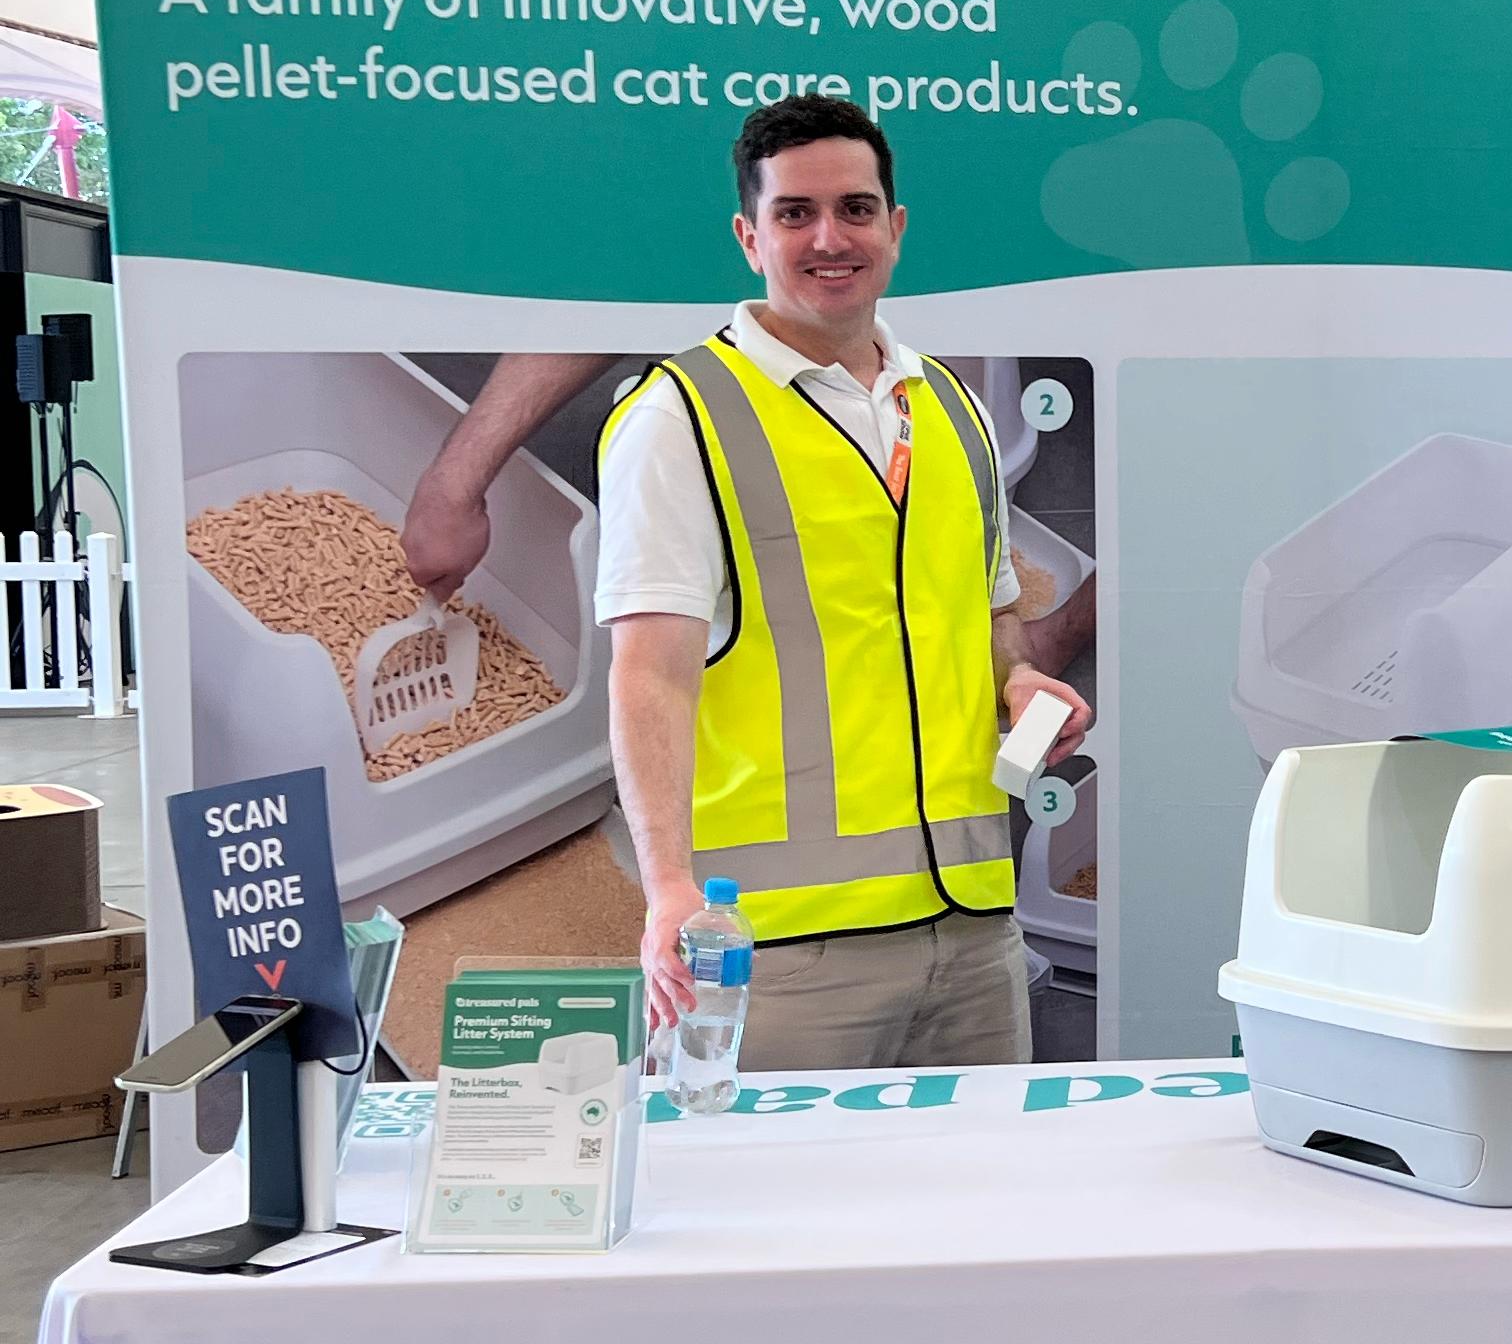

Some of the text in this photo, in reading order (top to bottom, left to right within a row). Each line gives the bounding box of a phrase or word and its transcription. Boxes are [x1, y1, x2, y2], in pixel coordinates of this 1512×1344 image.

[166, 44, 596, 111] pellet-focused
[613, 63, 709, 106] cat
[868, 62, 1139, 123] products.
[1039, 393, 1055, 416] 2
[1042, 790, 1058, 813] 3
[205, 793, 288, 838] SCAN
[220, 837, 284, 877] FOR
[213, 875, 304, 919] MORE
[228, 916, 302, 958] INFO
[453, 1014, 552, 1029] Premium Sifting
[453, 1027, 535, 1042] Litter System
[449, 1088, 511, 1099] Reinvented.
[450, 1076, 523, 1089] The Litterbox,
